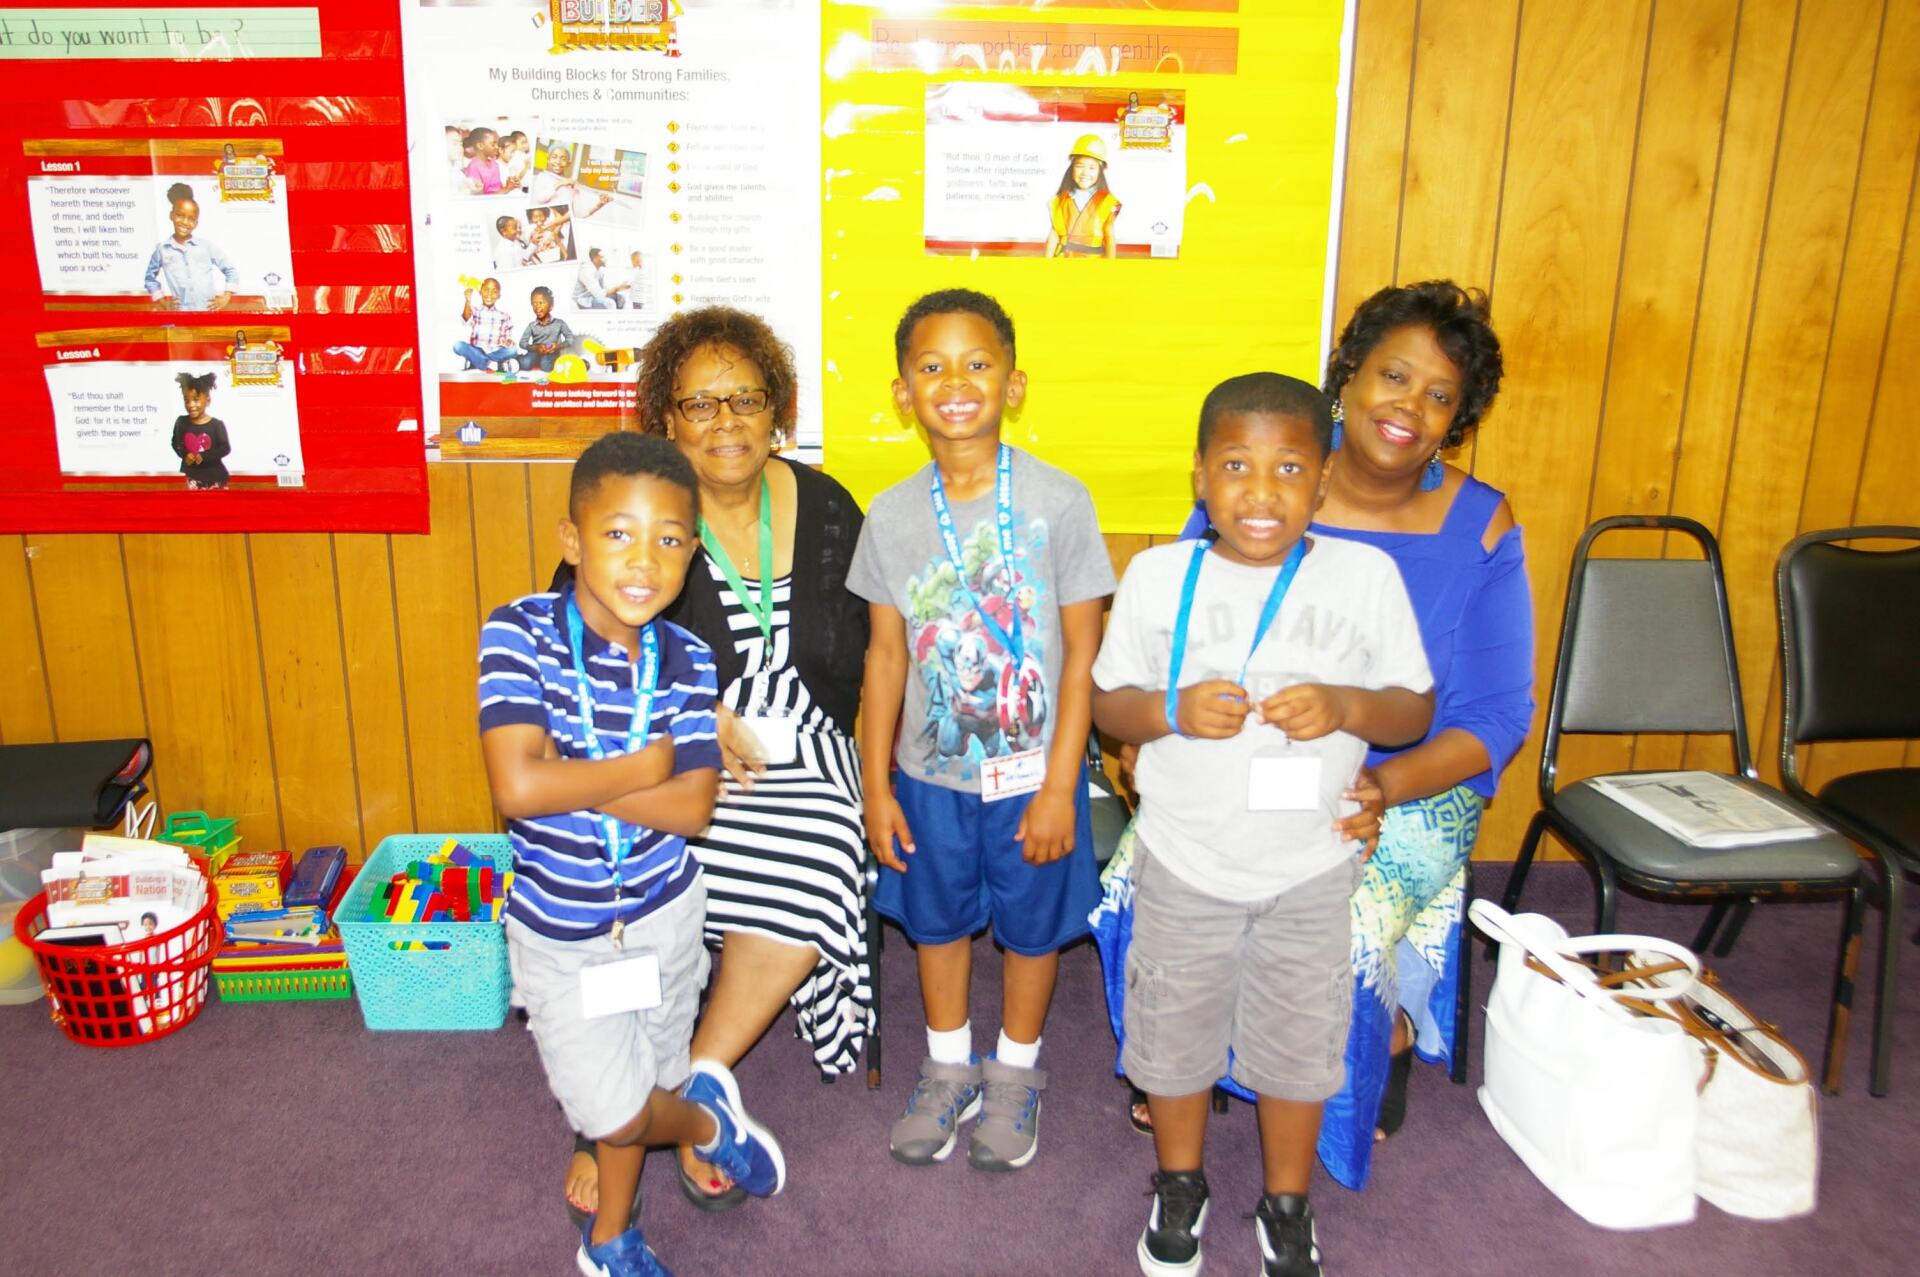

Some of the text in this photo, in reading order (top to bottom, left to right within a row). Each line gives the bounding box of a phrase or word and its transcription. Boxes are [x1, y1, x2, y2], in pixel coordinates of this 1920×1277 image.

[28, 19, 54, 45] do
[61, 30, 92, 54] you
[99, 17, 150, 44] want
[489, 67, 732, 84] My Building Blocks for Strong Families,
[531, 87, 589, 101] Churches
[592, 88, 602, 101] &
[40, 160, 81, 172] Lesson 1
[89, 186, 130, 195] whosoever
[50, 199, 136, 210] heareth these sayings
[51, 211, 125, 223] of mine, and doeth
[82, 225, 97, 234] will
[98, 225, 118, 234] liken
[119, 225, 135, 234] him
[55, 239, 73, 247] unto
[82, 239, 99, 247] wise
[57, 250, 139, 260] which built his house
[59, 264, 79, 273] upon
[56, 347, 101, 360] Lesson 4
[86, 391, 104, 400] thou
[532, 390, 545, 398] For
[544, 390, 554, 398] he
[568, 390, 592, 399] looking
[592, 390, 618, 398] forward
[618, 390, 626, 398] to
[74, 403, 158, 414] remember the Lord thy
[583, 400, 596, 408] and
[618, 400, 626, 408] is
[93, 416, 104, 425] for
[105, 416, 112, 425] it
[113, 417, 121, 425] is
[121, 416, 131, 425] he
[132, 416, 148, 425] that
[76, 429, 99, 438] giveth
[100, 429, 118, 438] thee
[119, 430, 142, 439] power
[136, 884, 167, 896] Nation
